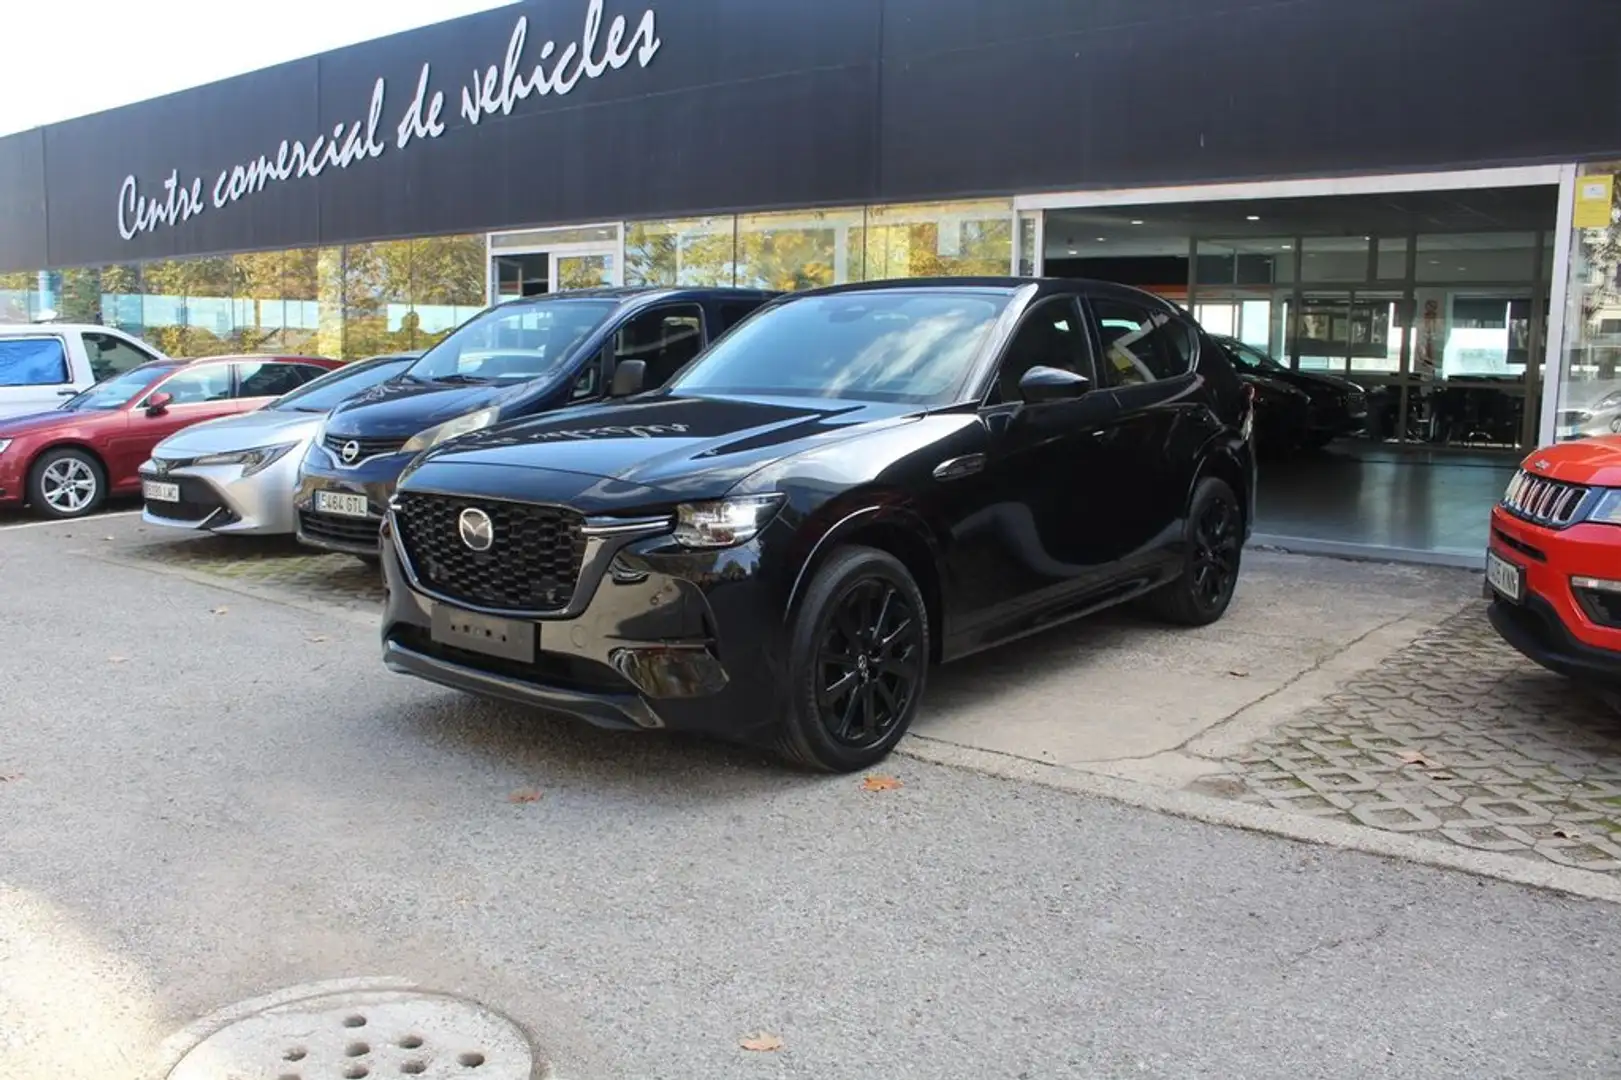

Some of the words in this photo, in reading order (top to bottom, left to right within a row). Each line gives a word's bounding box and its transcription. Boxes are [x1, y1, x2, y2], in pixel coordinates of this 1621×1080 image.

[117, 168, 204, 241] Centre
[212, 77, 385, 209] comercial
[396, 62, 445, 149] de
[460, 0, 661, 124] vehicles
